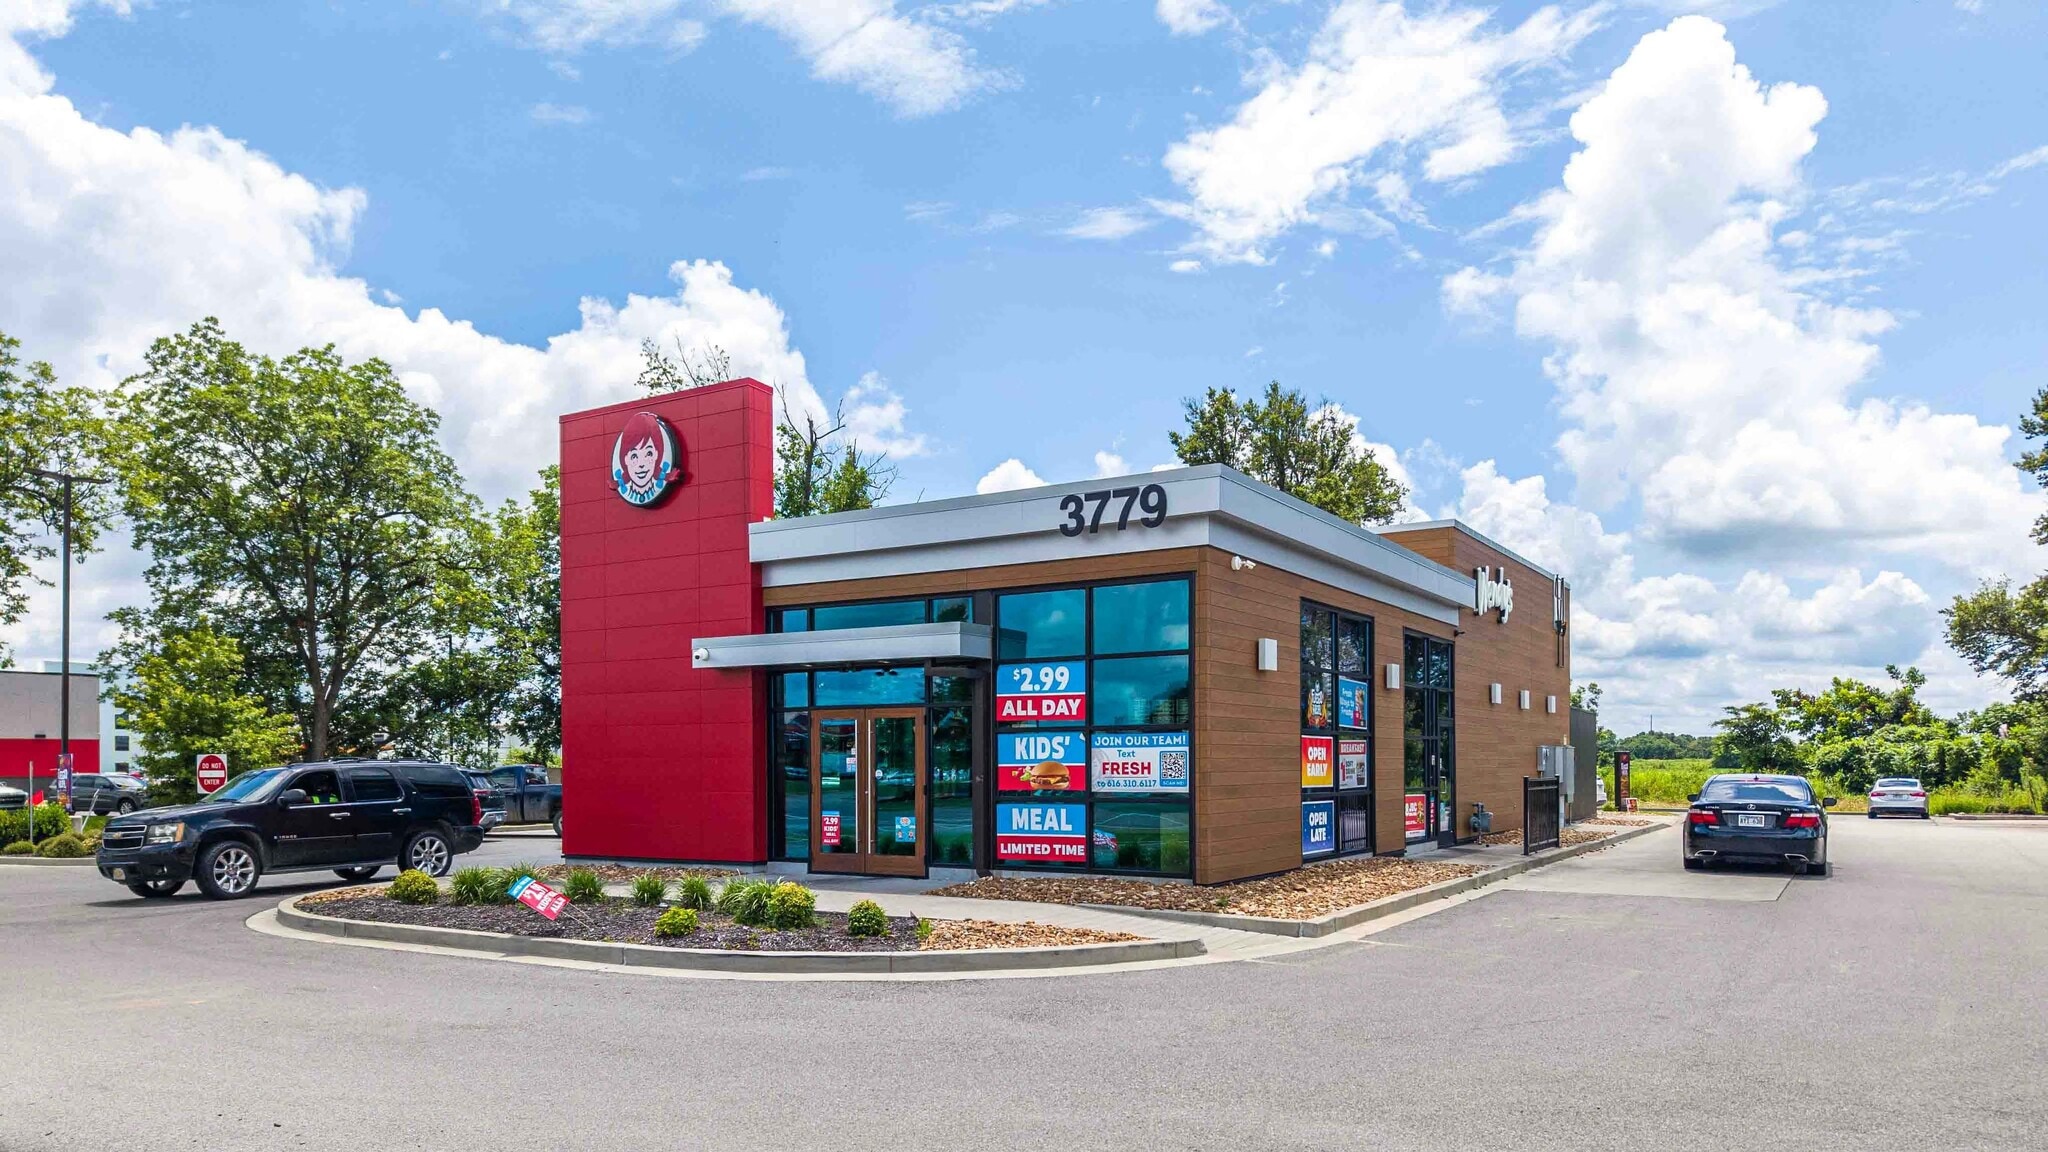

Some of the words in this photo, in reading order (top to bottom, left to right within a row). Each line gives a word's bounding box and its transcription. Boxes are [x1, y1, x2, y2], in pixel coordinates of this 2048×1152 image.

[1059, 483, 1167, 537] 3779
[1013, 666, 1070, 692] $2.99
[1002, 700, 1038, 716] ALL
[1042, 699, 1081, 716] DAY
[1015, 736, 1070, 760] KIDS'
[1094, 736, 1122, 746] JOIN
[1125, 736, 1149, 745] OUR
[1152, 735, 1186, 745] TEAM!
[1117, 749, 1136, 758] Text
[1307, 746, 1327, 761] OPEN
[1102, 762, 1151, 775] FRESH
[1307, 763, 1328, 777] EARLY
[1097, 780, 1106, 788] to
[1107, 780, 1157, 788] 616.310.6117
[1012, 808, 1072, 832] MEAL
[1309, 811, 1328, 827] OPEN
[1310, 827, 1327, 842] LATE
[1000, 842, 1051, 855] LIMITED
[1053, 843, 1085, 856] TIME
